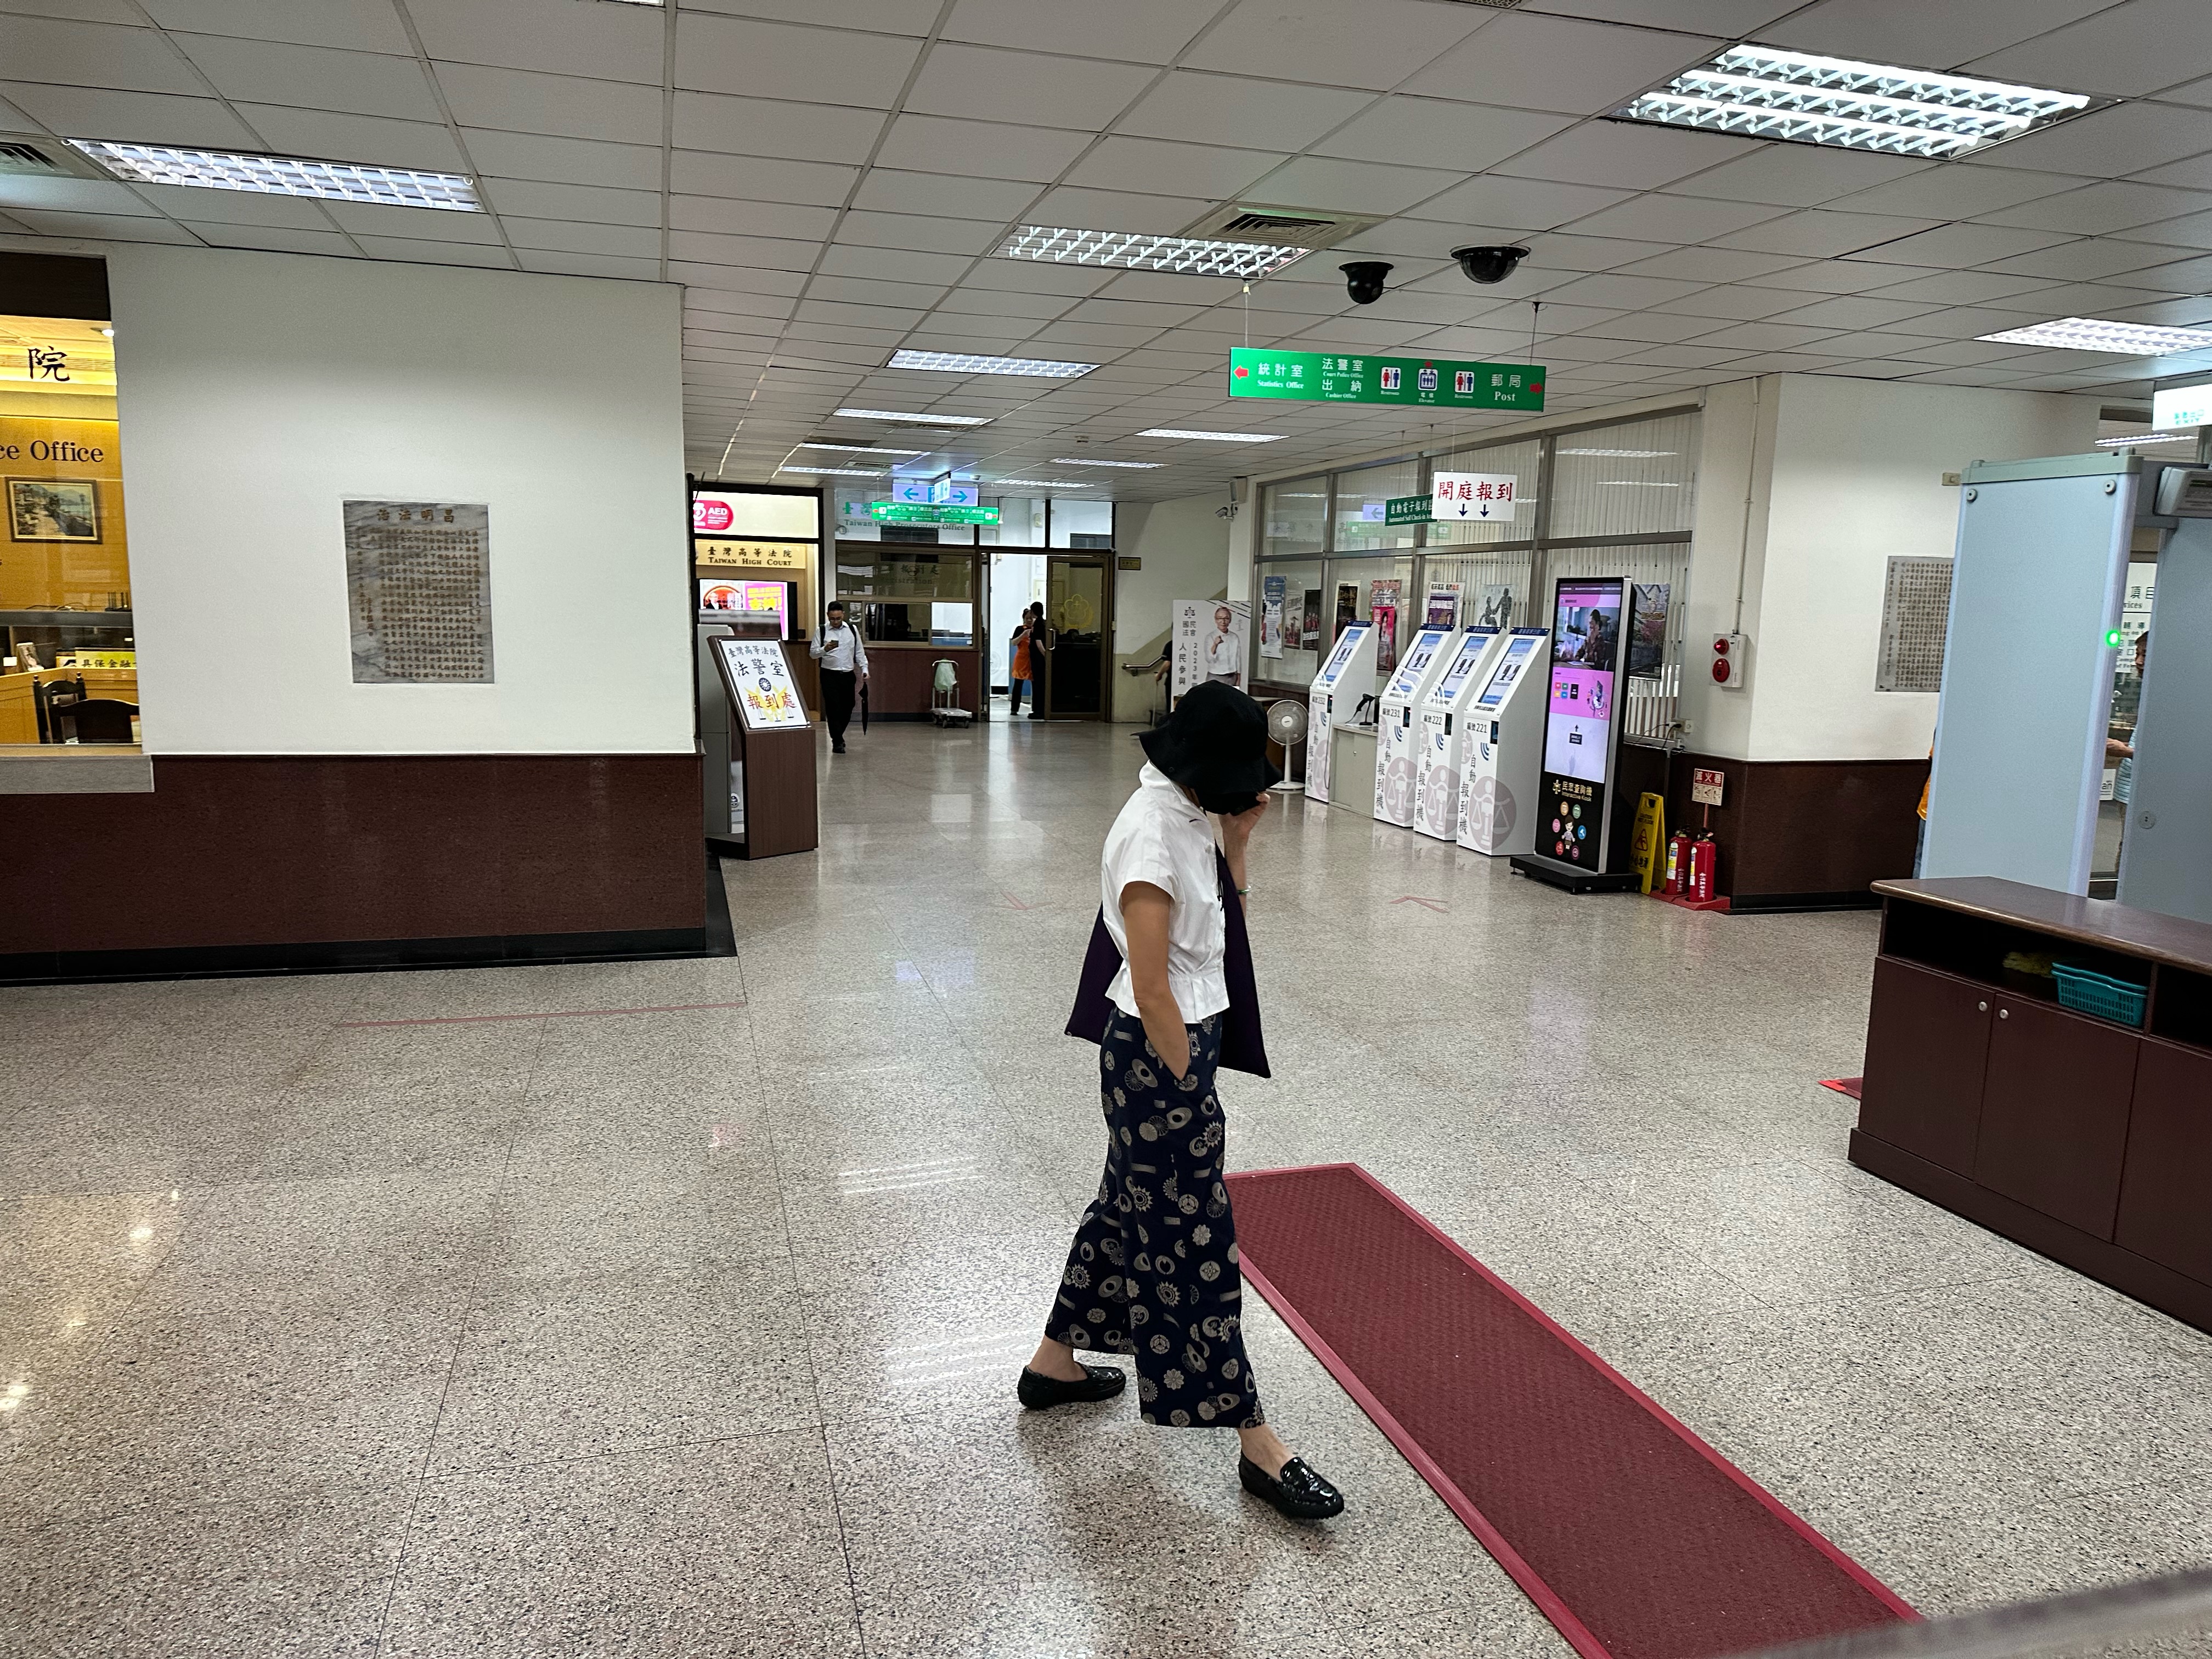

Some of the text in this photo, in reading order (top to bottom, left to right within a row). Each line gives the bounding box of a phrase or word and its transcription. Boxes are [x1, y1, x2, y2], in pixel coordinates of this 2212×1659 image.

[27, 345, 70, 382] 院
[1258, 362, 1304, 377] 統計室
[1322, 358, 1363, 371] 法警室
[1257, 380, 1304, 390] Statistics Office
[1322, 379, 1362, 392] 出納
[1491, 374, 1521, 388] 郵局
[1494, 391, 1515, 402] Post
[30, 440, 104, 462] Office
[1438, 481, 1514, 502] 開庭報到
[845, 519, 874, 527] Taiwan
[942, 523, 966, 531] Office
[708, 546, 792, 558] 臺灣高等法院
[729, 645, 778, 658] 臺灣高等法院
[81, 659, 136, 668] 具保金融
[734, 658, 785, 677] 法警室
[747, 692, 797, 710] 報到處
